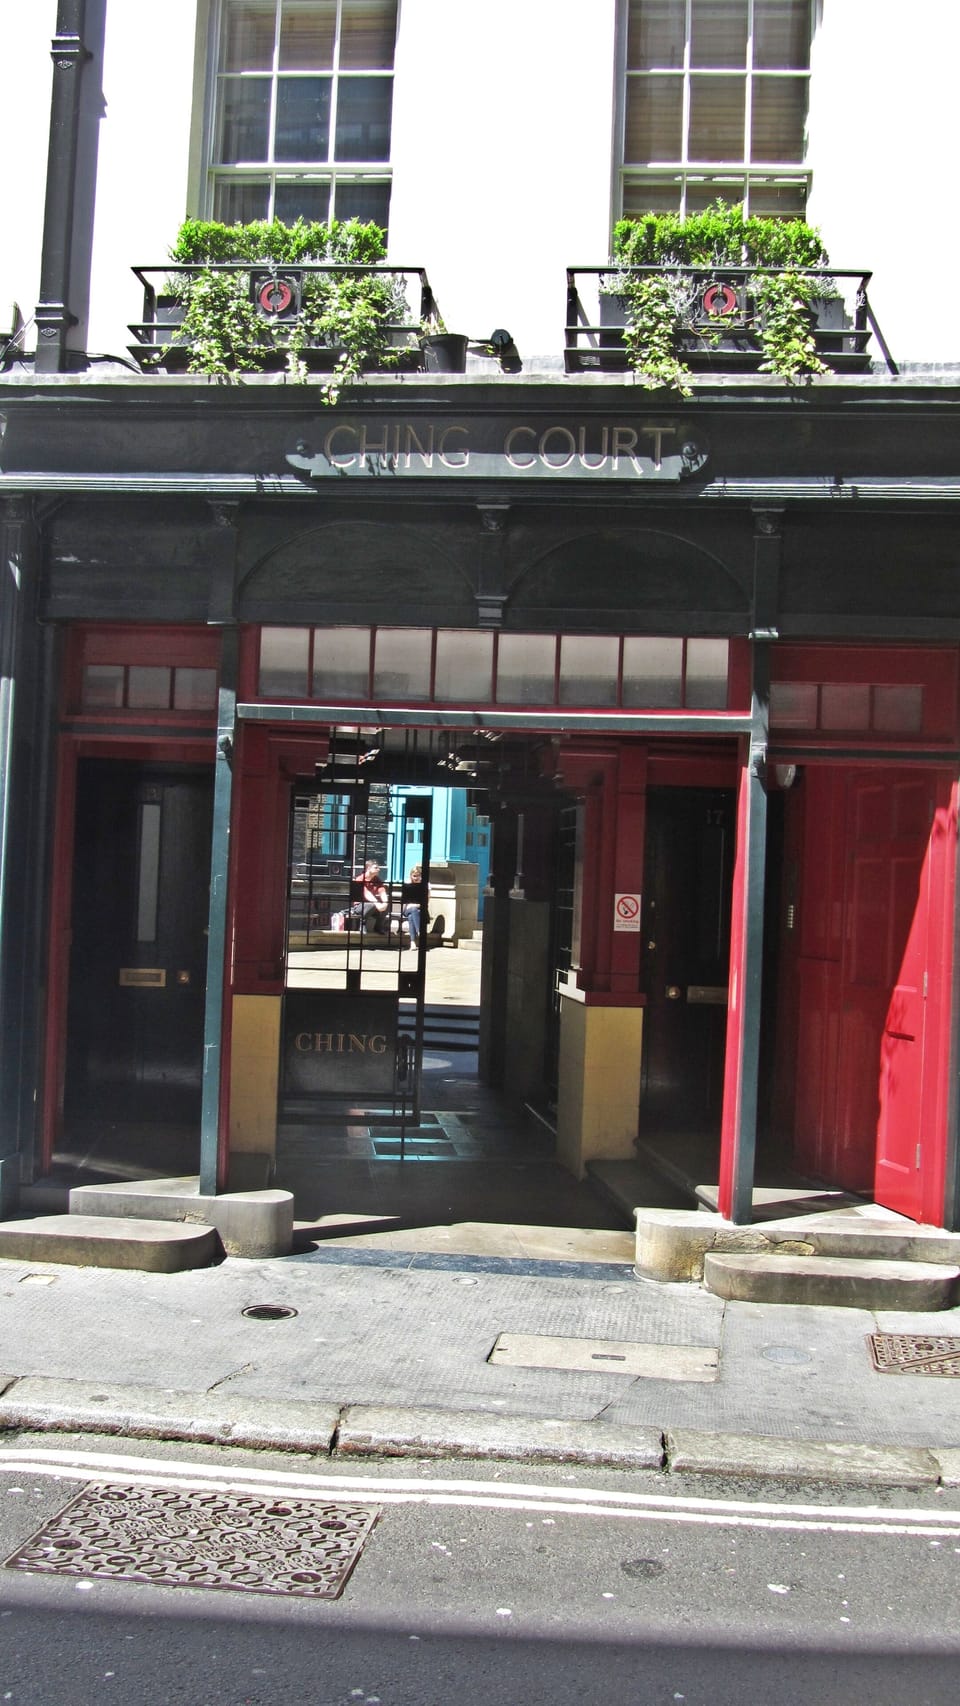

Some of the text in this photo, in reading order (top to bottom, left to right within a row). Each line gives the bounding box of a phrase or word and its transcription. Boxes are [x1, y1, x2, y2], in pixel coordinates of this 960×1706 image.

[324, 425, 676, 474] CHING COURT
[295, 1032, 387, 1054] CHING
